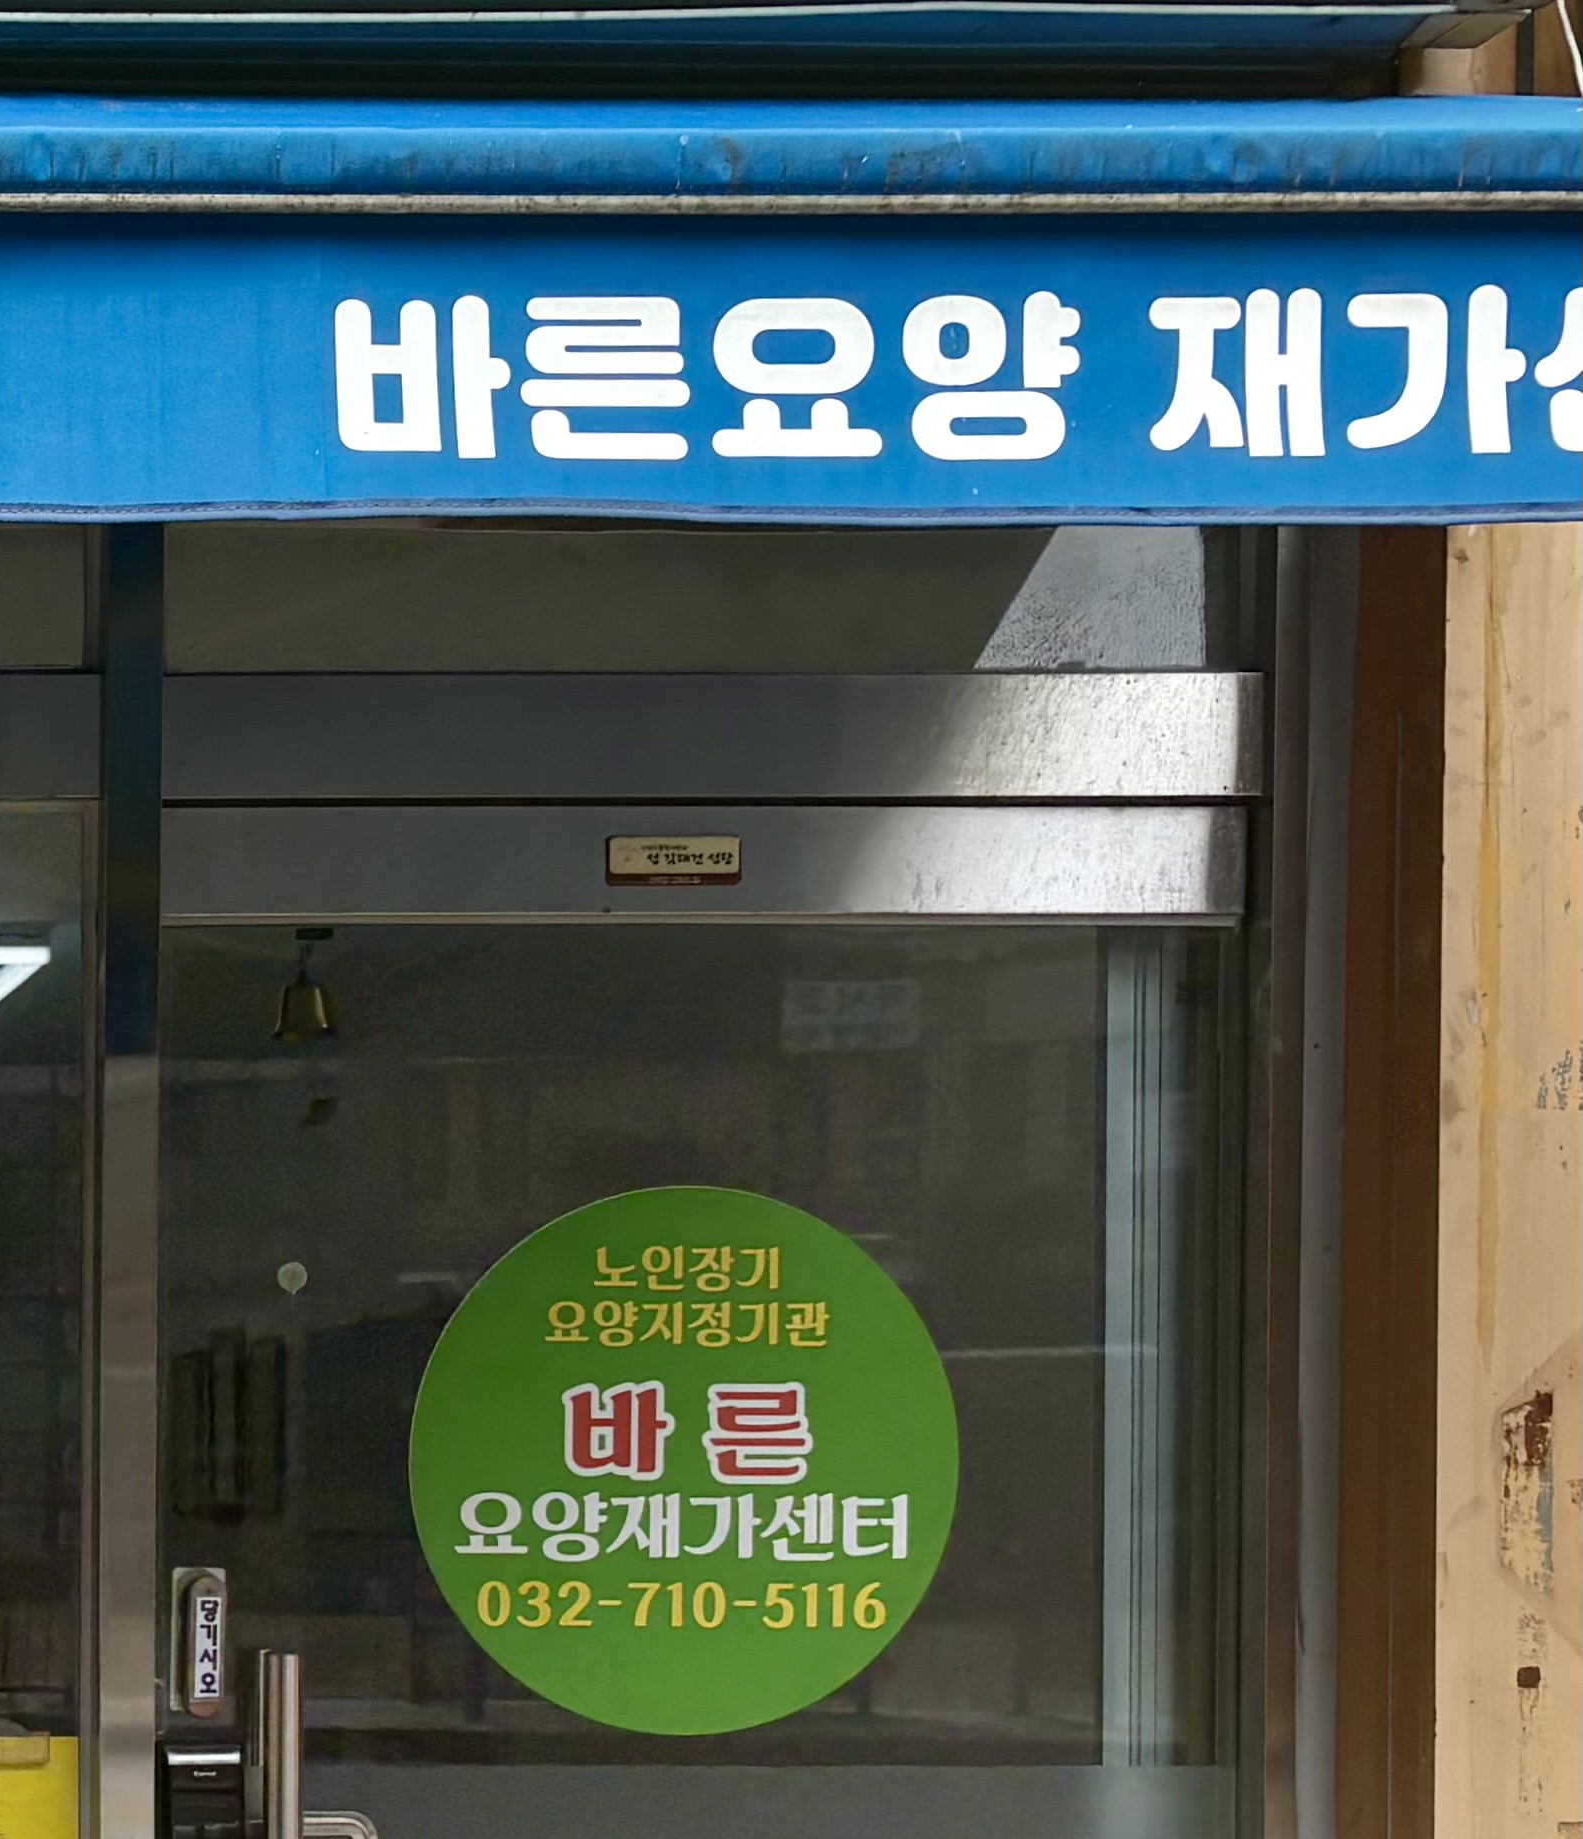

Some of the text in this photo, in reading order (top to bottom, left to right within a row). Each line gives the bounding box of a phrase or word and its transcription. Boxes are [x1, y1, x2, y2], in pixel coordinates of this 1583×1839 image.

[334, 288, 1081, 462] 바른요양
[592, 1244, 782, 1292] 노인장기
[543, 1300, 831, 1348] 요양지정기관
[453, 1490, 909, 1563] 요양재가센터
[476, 1579, 889, 1631] 032-710-5116
[198, 1599, 221, 1694] 당기시오
